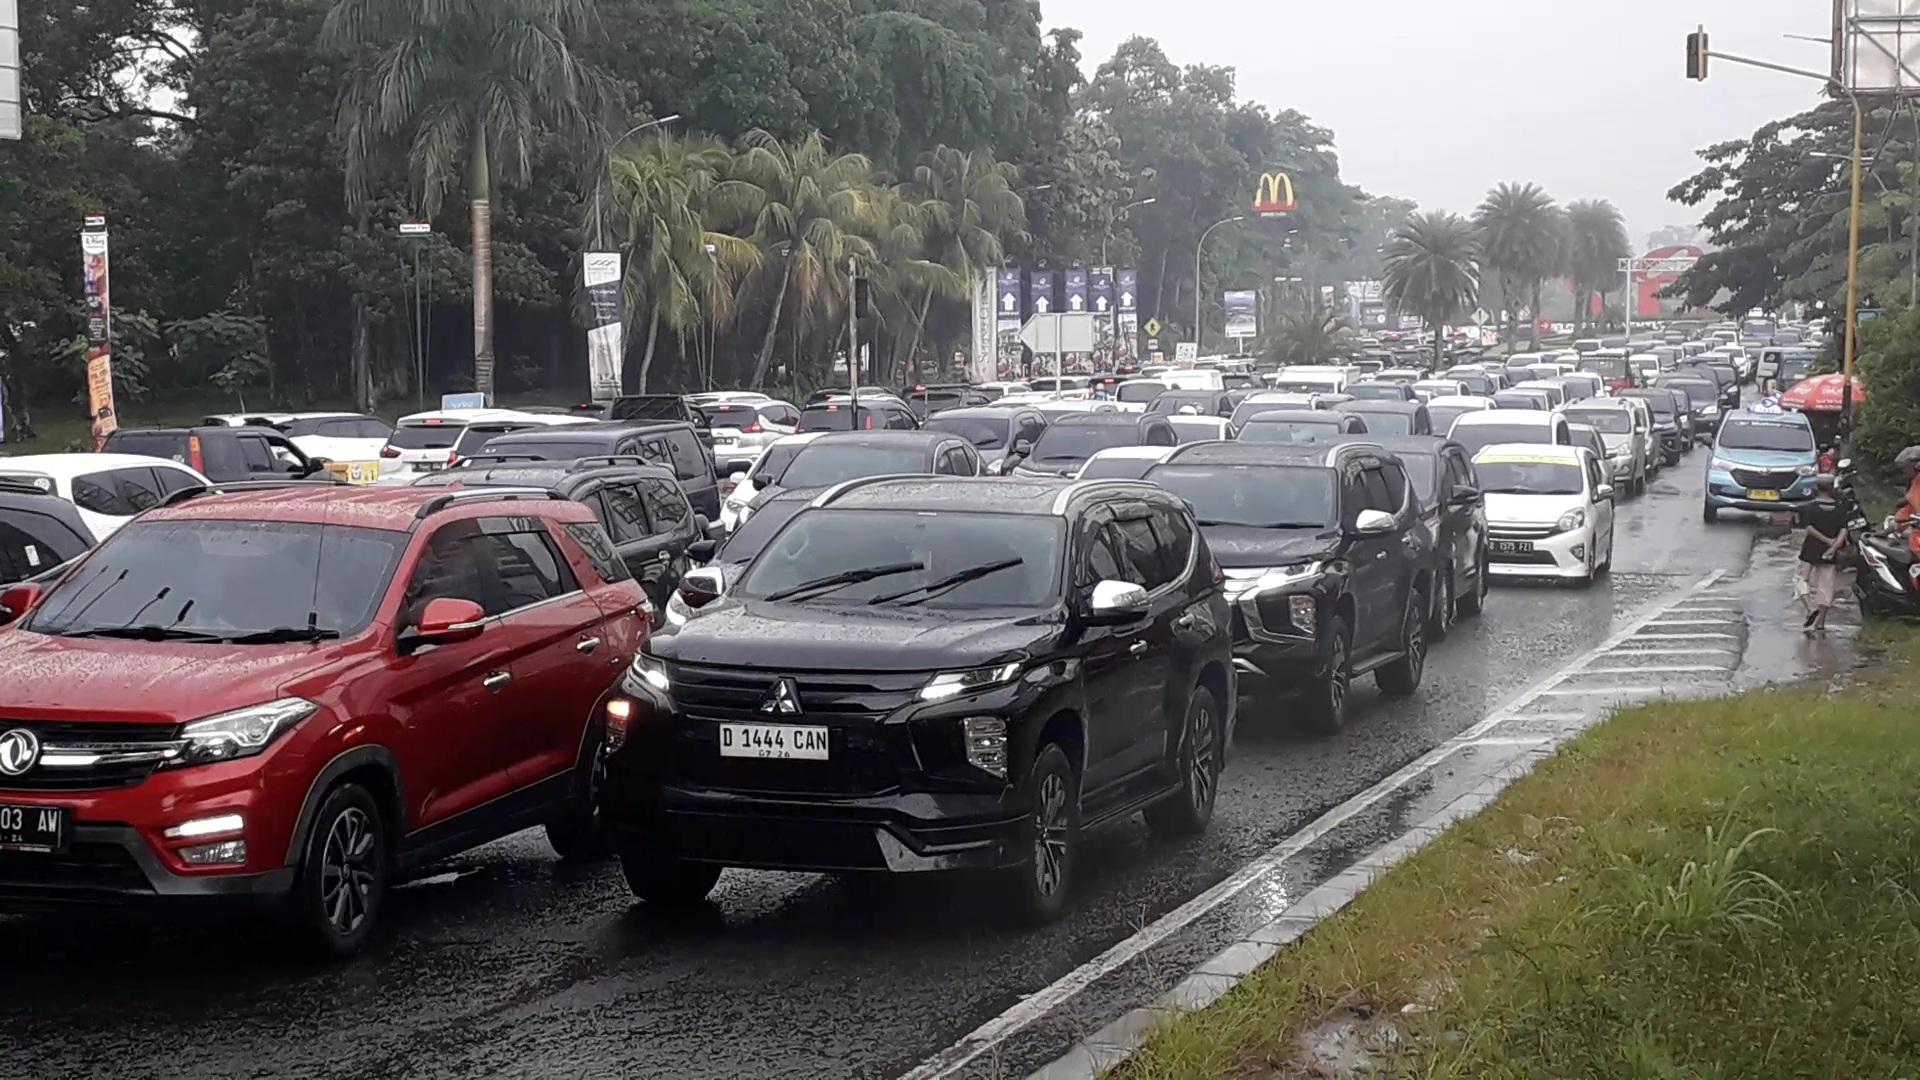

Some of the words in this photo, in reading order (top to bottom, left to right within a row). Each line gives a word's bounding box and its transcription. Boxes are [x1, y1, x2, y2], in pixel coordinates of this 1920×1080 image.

[723, 727, 732, 747] D
[742, 728, 784, 748] 1444
[793, 730, 827, 750] CAN
[37, 809, 57, 832] AW
